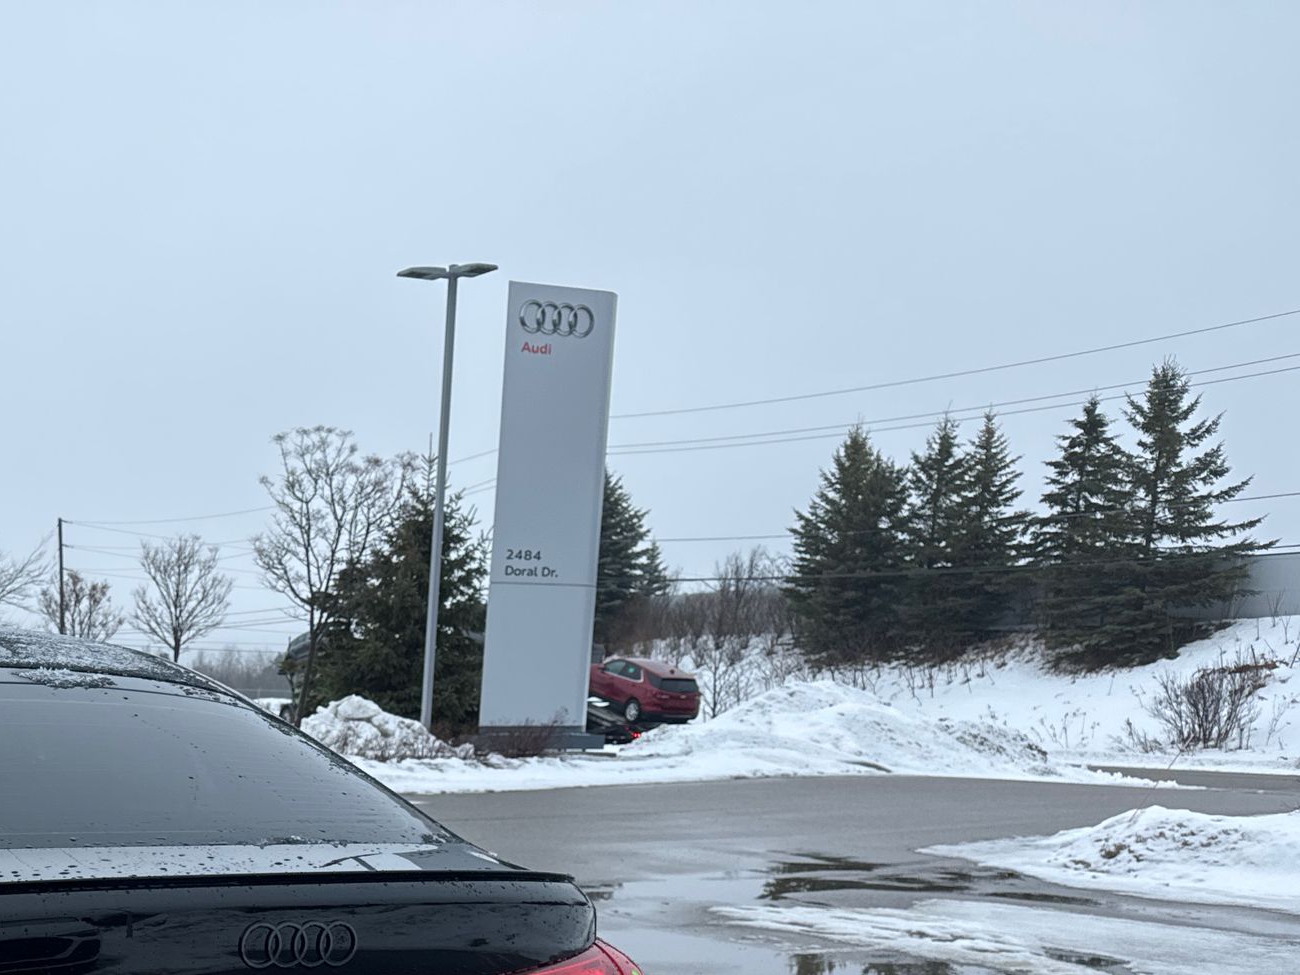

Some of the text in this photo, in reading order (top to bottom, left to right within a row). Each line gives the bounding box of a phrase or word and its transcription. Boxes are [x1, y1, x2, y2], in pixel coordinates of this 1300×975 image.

[520, 341, 552, 355] Audi
[505, 548, 542, 561] 2484
[504, 564, 559, 578] Doral Dr.
